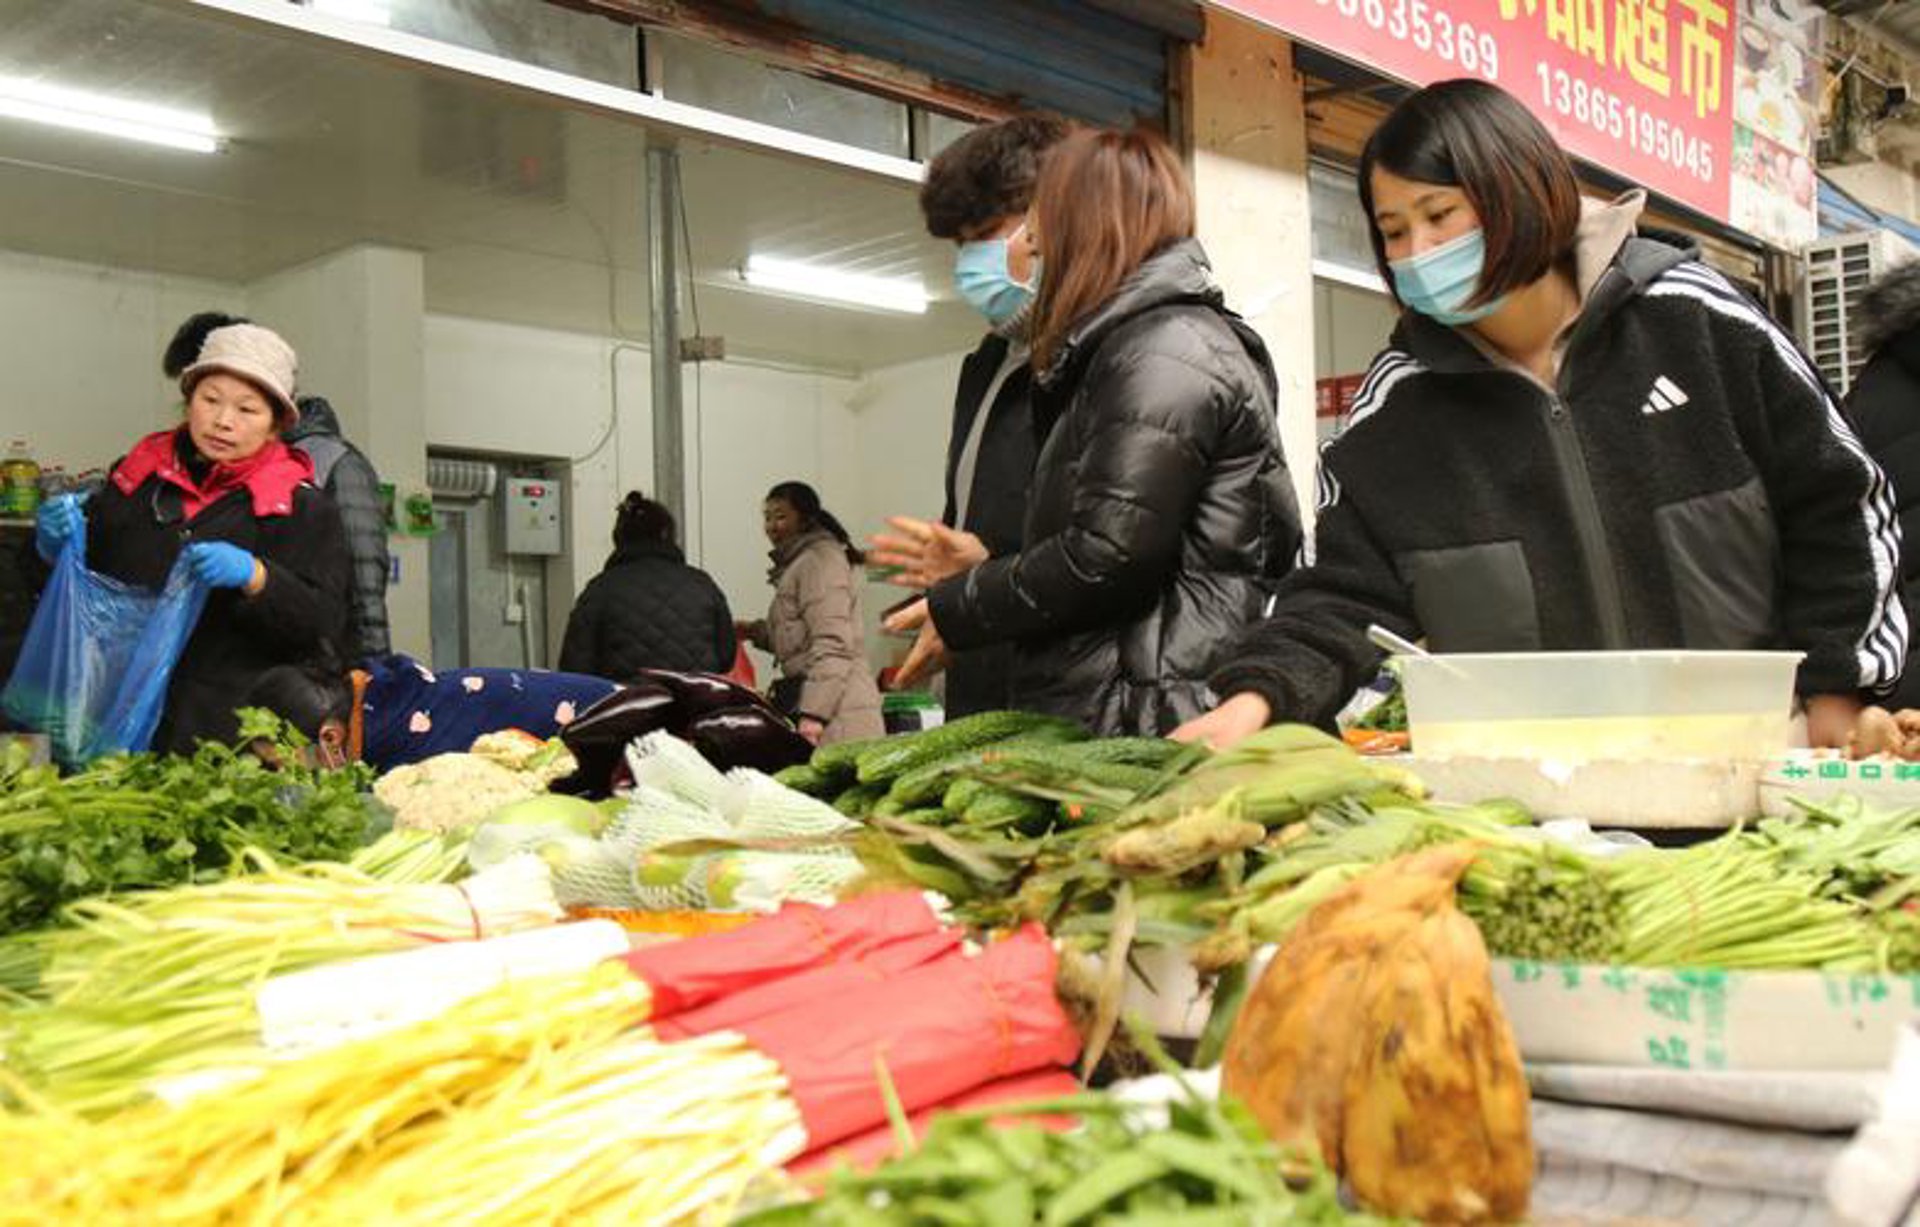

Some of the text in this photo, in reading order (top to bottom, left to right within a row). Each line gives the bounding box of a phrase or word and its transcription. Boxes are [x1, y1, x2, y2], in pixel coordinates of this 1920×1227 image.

[1315, 0, 1498, 80] 635369
[1500, 0, 1728, 119] 品超市
[1535, 60, 1713, 183] 13865195045
